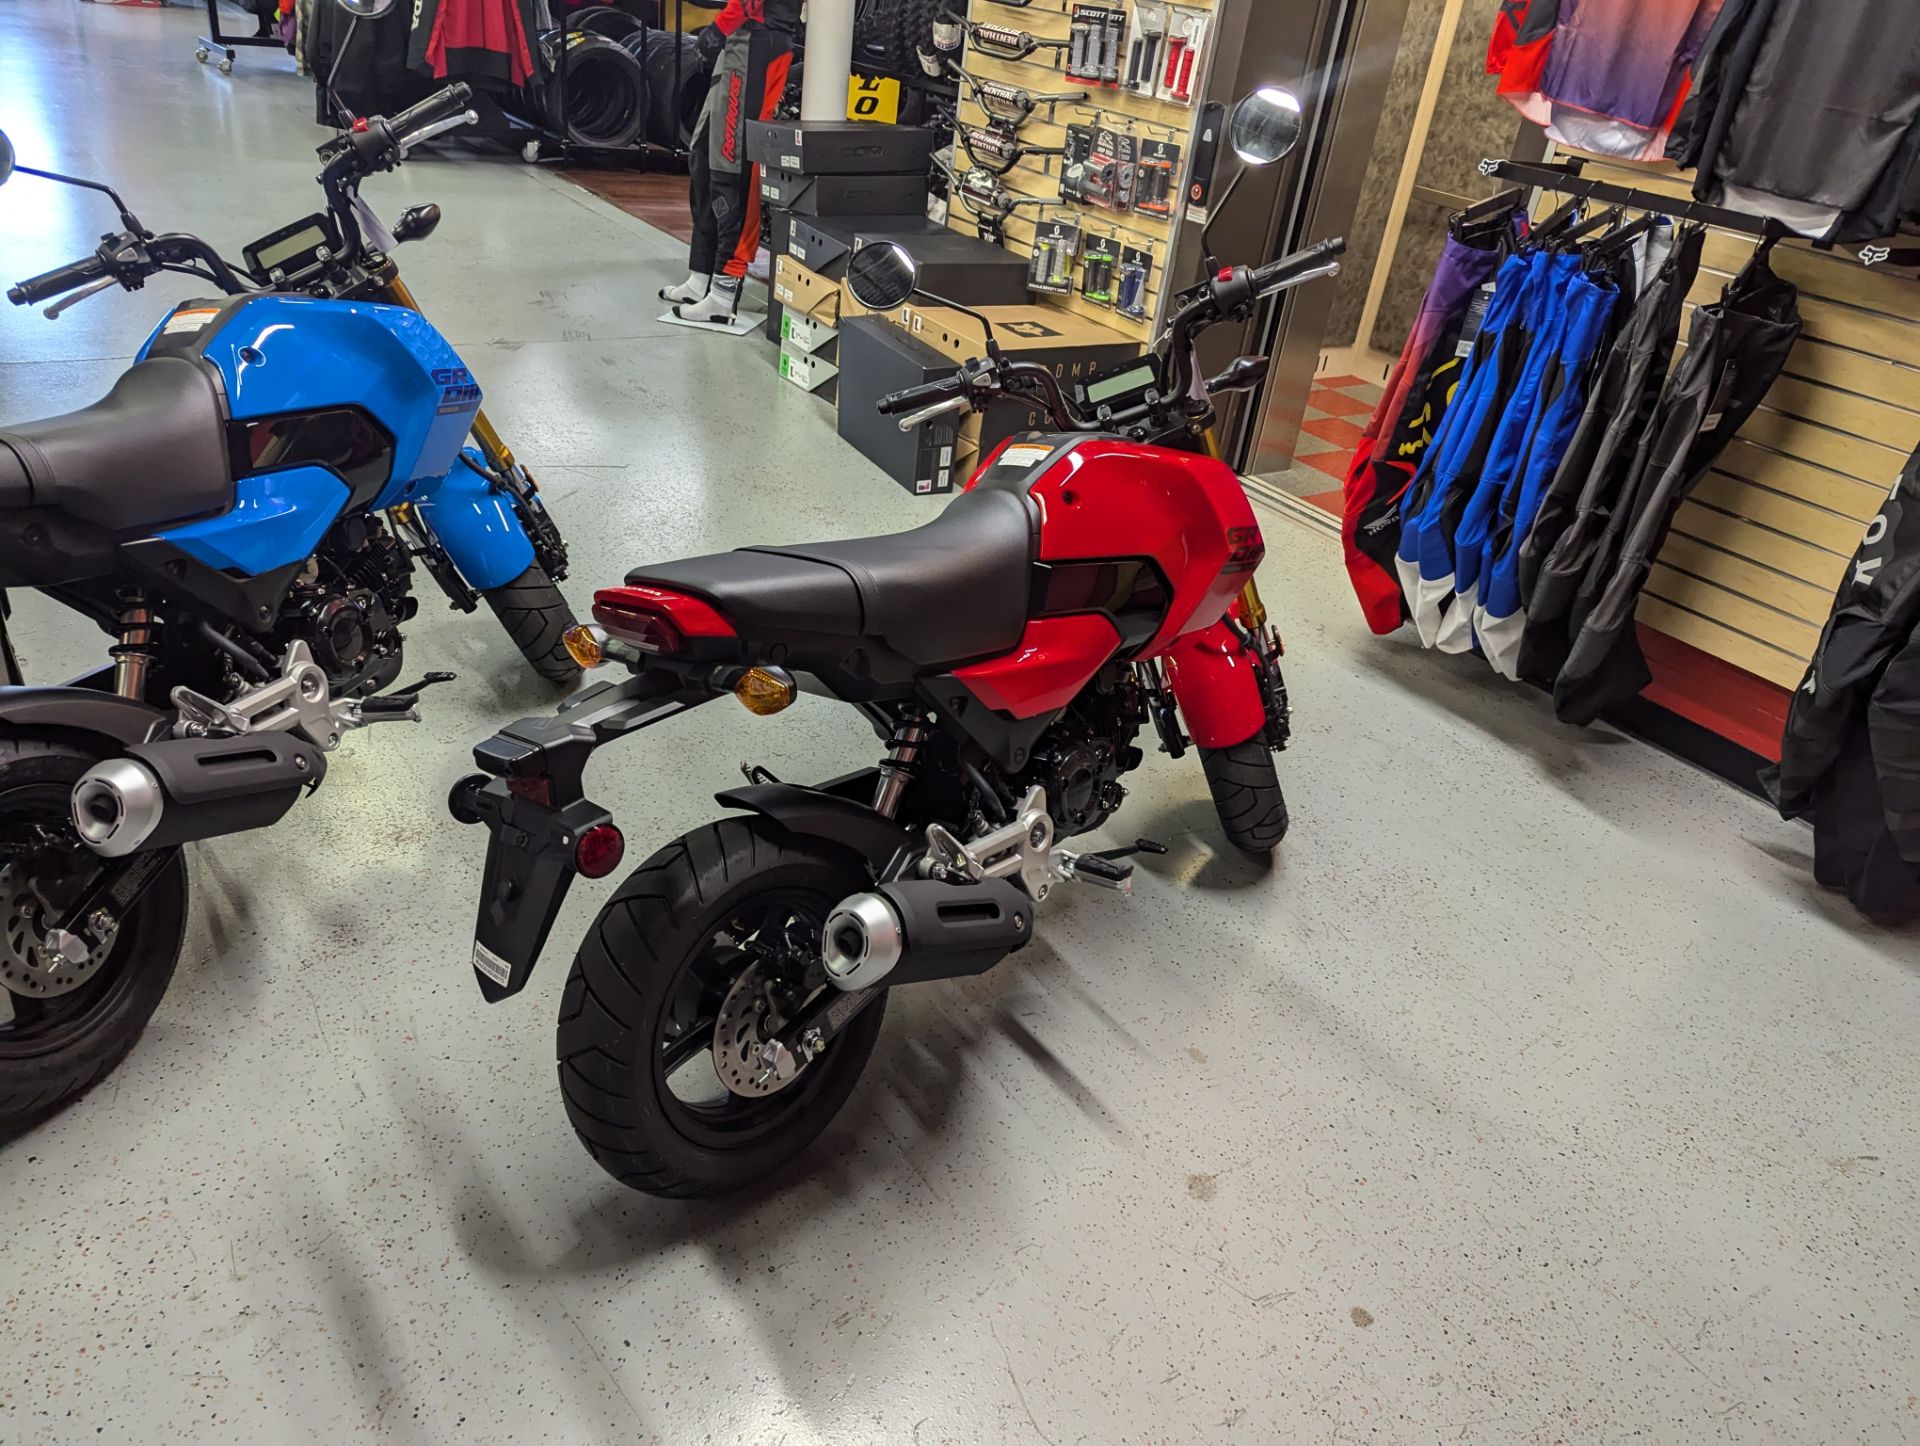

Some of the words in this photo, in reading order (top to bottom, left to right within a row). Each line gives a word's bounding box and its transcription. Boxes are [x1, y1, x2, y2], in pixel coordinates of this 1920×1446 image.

[1080, 9, 1107, 19] SCOTT
[978, 28, 1019, 46] RENTHAL
[721, 68, 743, 163] FASTHOUSE
